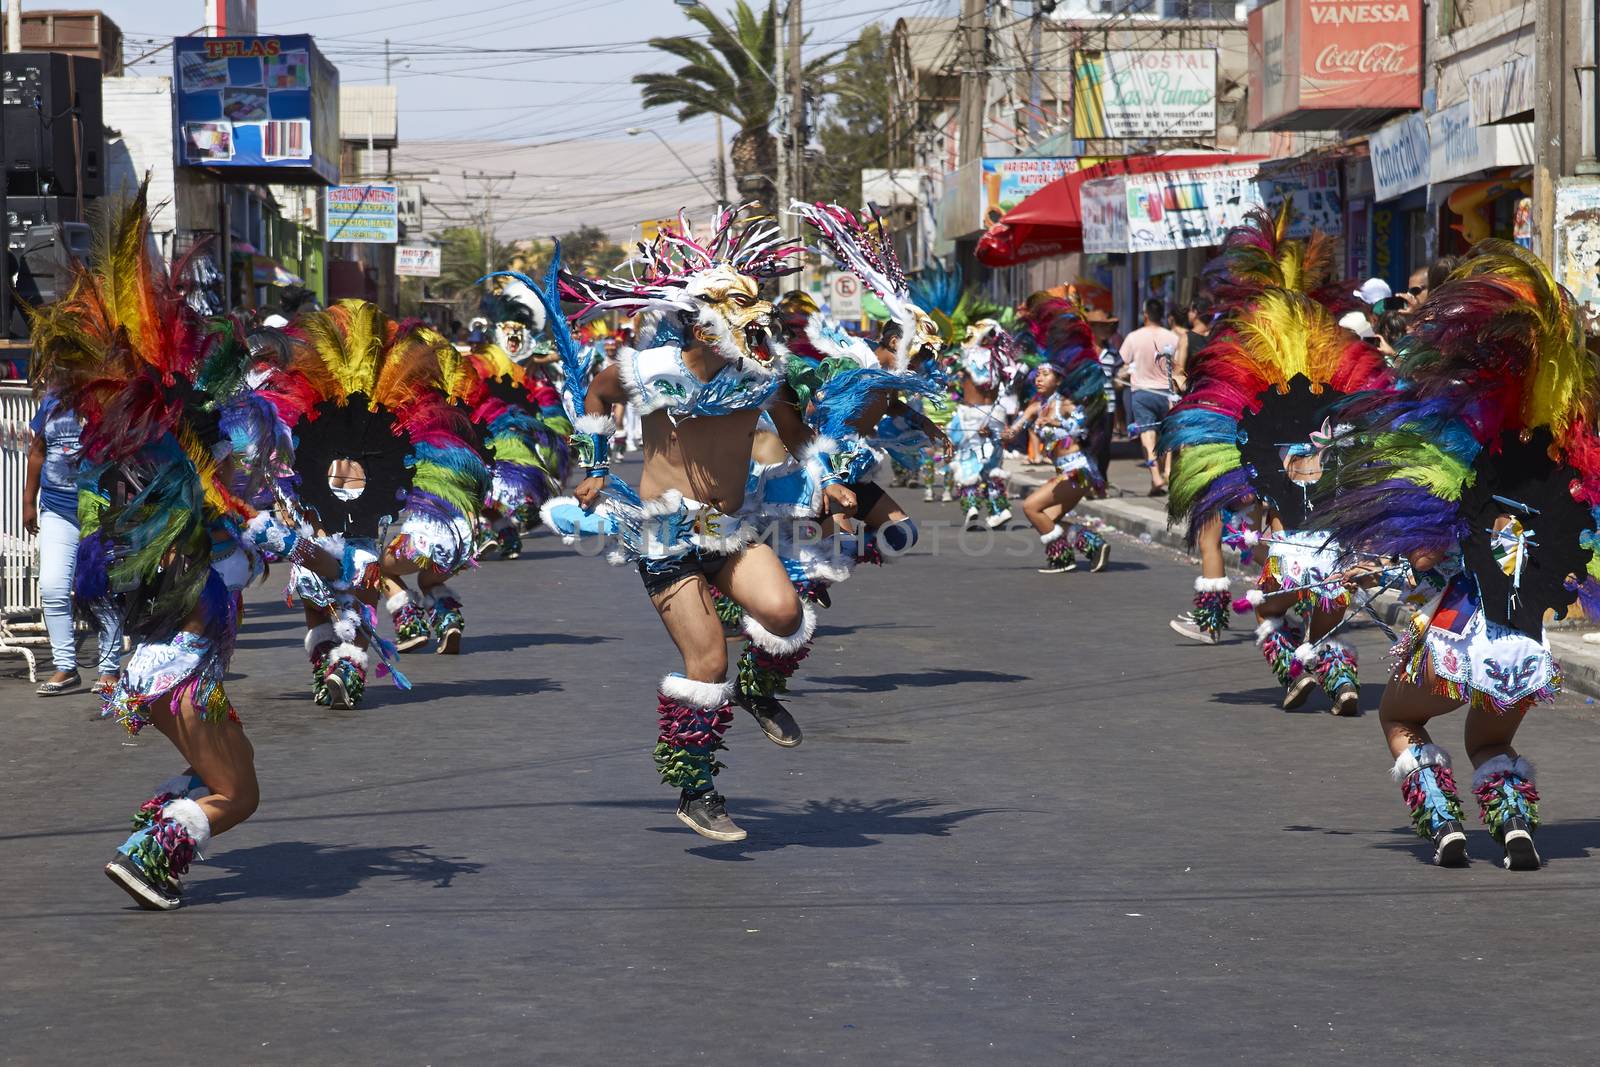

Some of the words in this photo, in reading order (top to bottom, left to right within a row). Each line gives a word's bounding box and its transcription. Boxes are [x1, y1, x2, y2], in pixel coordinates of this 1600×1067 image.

[1310, 5, 1410, 25] VANESSA
[204, 39, 280, 59] TELAS
[1315, 42, 1409, 74] Coca-Cola
[1131, 52, 1209, 70] HOSTAL
[1105, 68, 1142, 106] Las
[1144, 71, 1211, 106] Palmas
